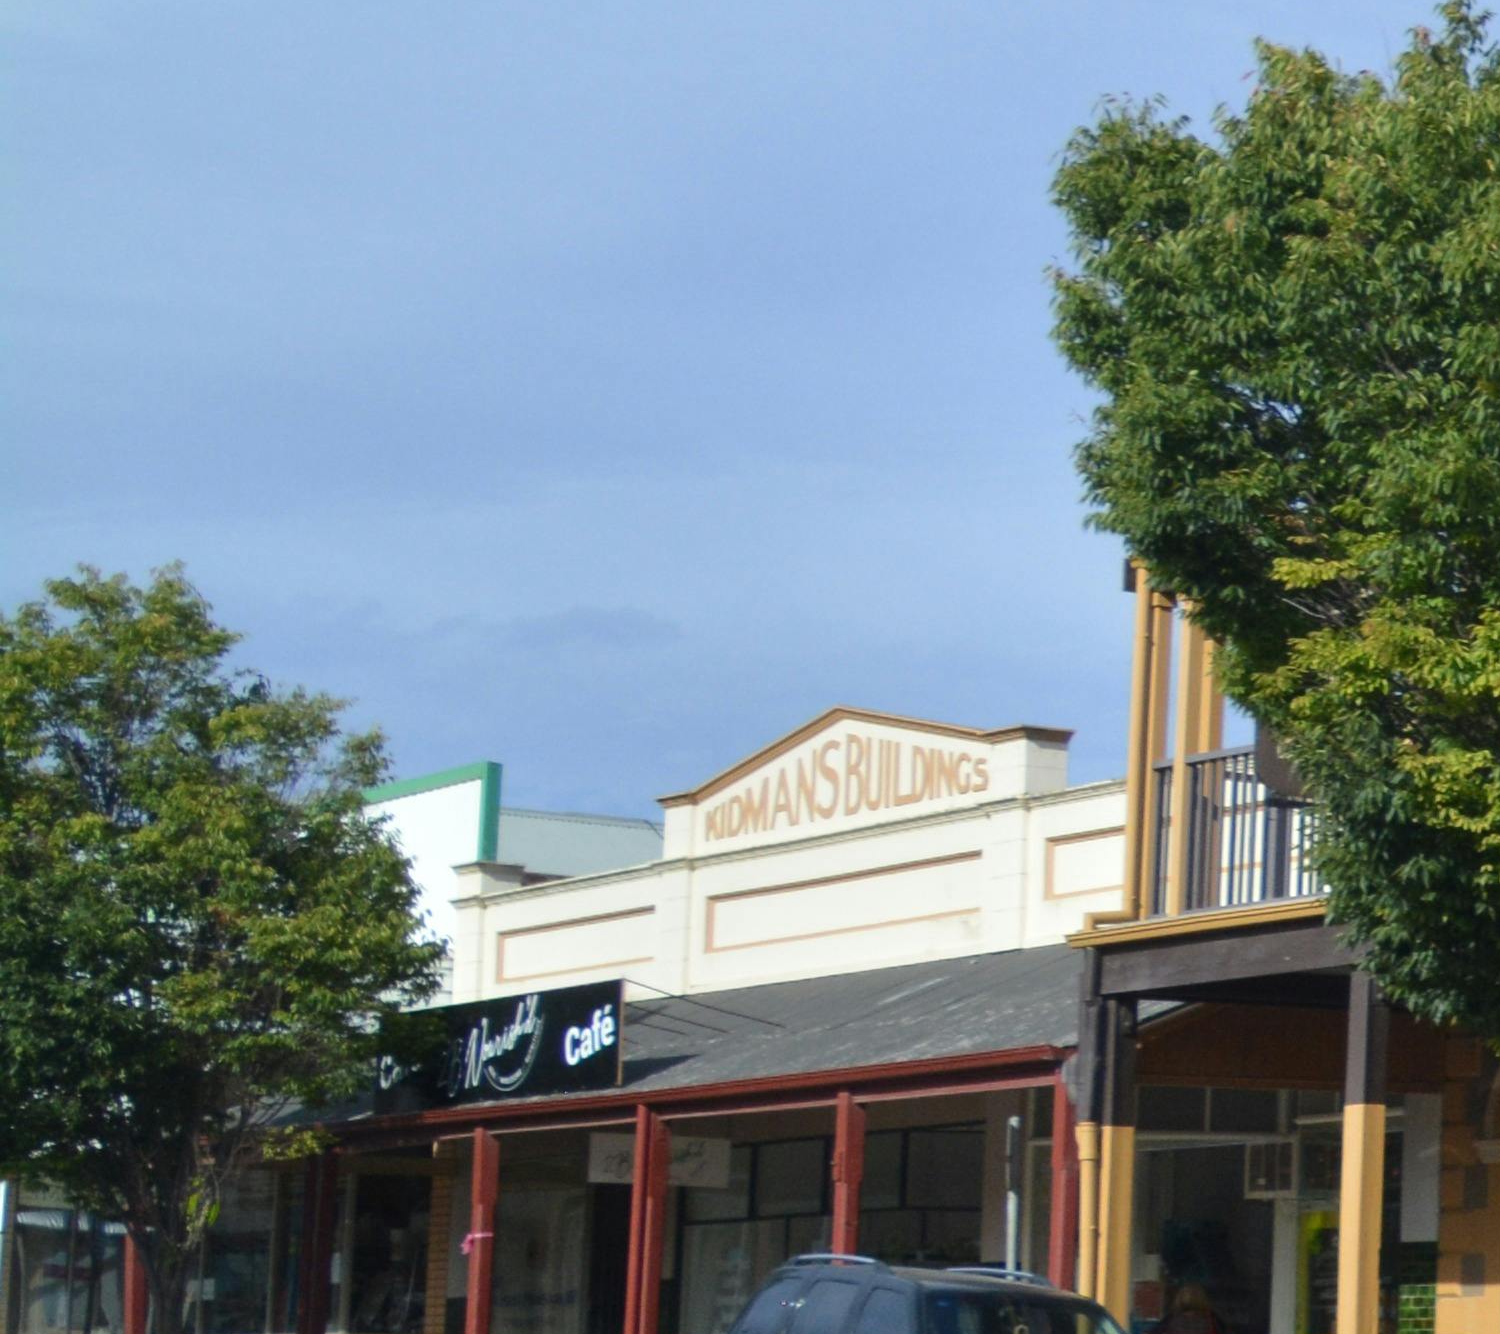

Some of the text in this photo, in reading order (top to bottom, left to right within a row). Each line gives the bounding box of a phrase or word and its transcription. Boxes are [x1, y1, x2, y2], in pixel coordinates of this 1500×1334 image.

[705, 732, 990, 841] KIDMANS BUILDINGS
[563, 1003, 618, 1067] Café
